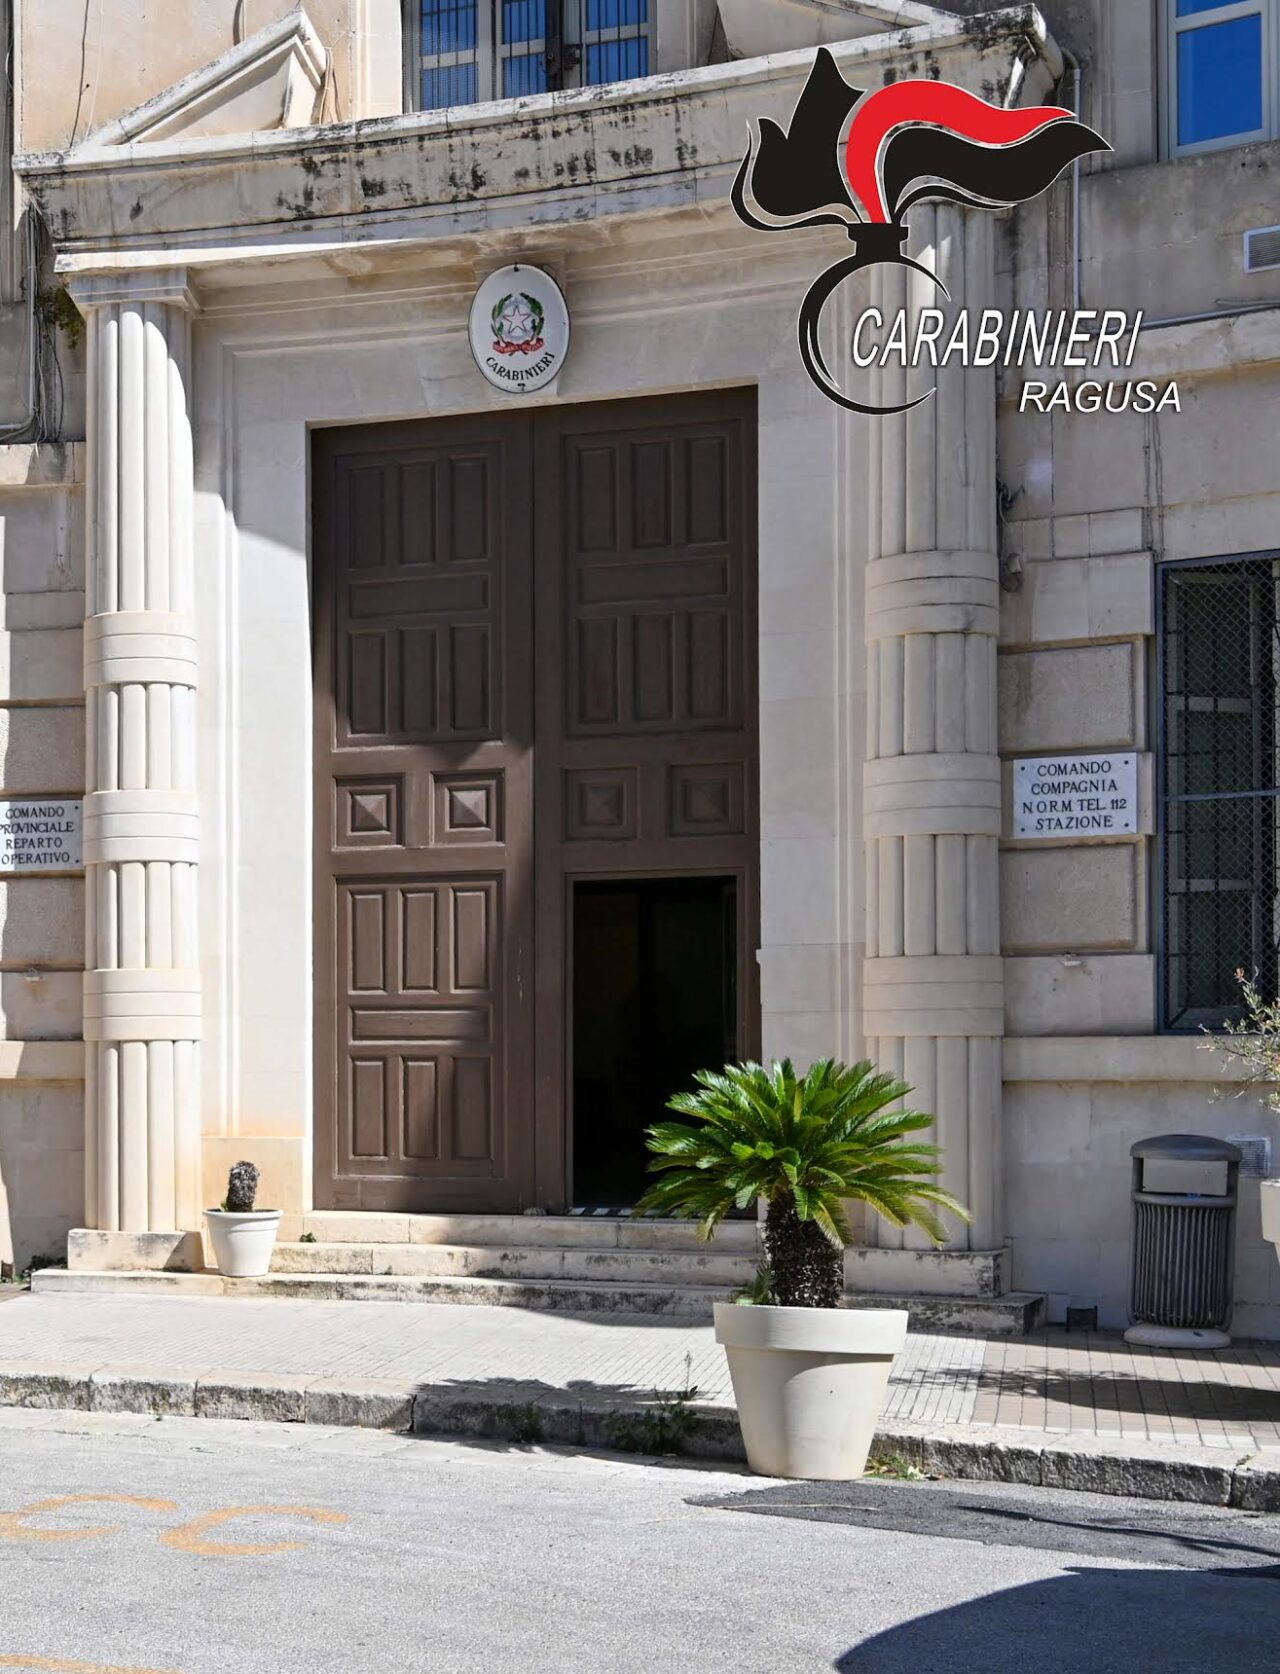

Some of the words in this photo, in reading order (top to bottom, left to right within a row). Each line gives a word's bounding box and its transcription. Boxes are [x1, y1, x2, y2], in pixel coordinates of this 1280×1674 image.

[485, 351, 555, 381] CARABINIERI
[1037, 760, 1112, 777] COMANDO
[1031, 779, 1118, 795] COMPAGNIA
[1110, 798, 1127, 810] 112
[5, 806, 65, 819] COMANDO
[1035, 815, 1113, 831] STAZIONE
[5, 837, 63, 850] REPARTO
[1, 852, 70, 865] OPERATIVO
